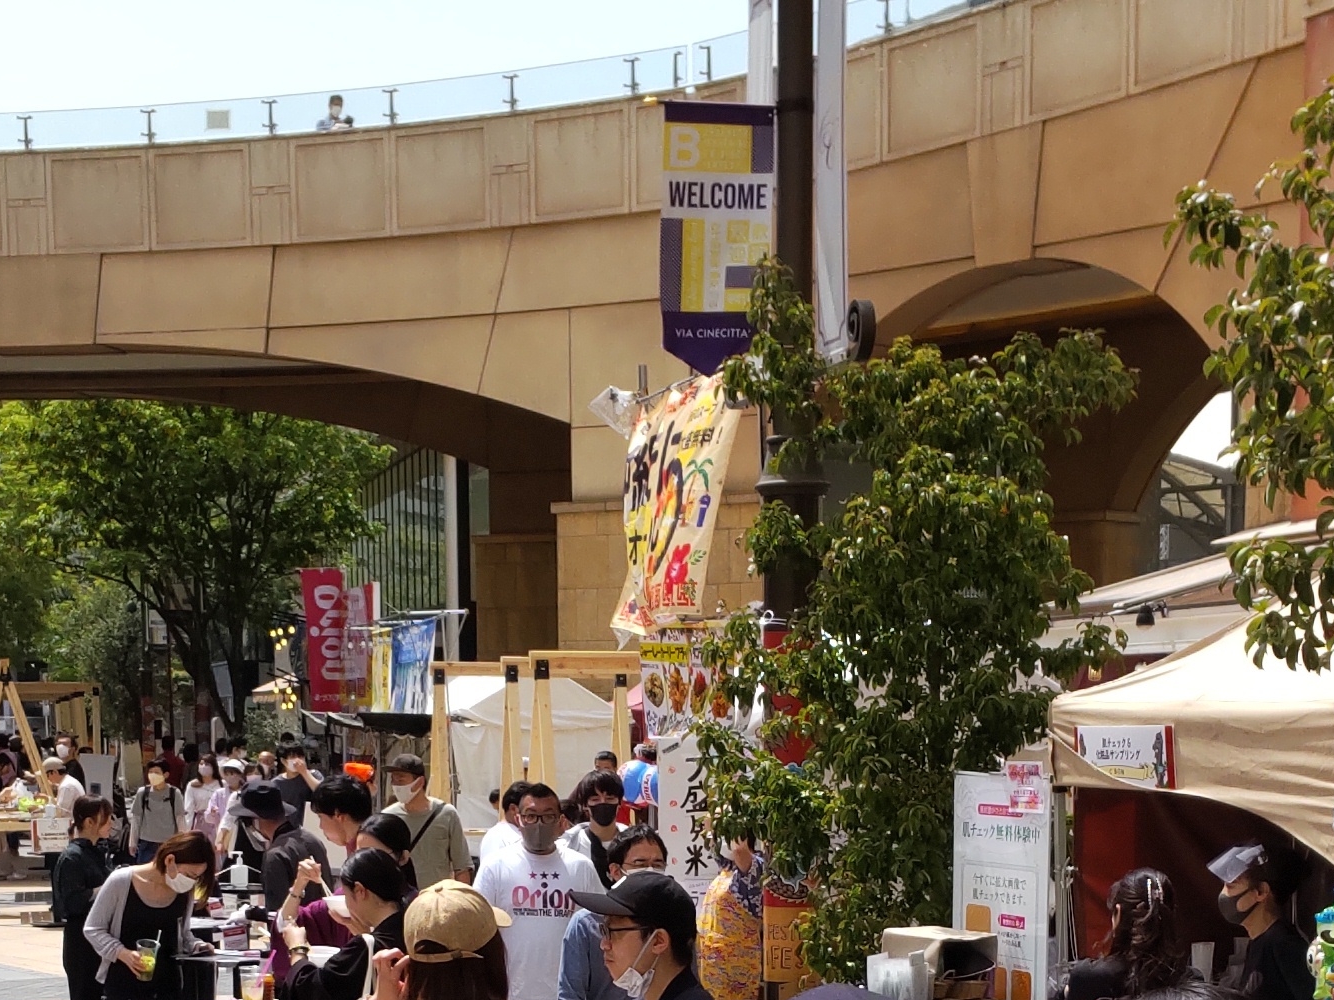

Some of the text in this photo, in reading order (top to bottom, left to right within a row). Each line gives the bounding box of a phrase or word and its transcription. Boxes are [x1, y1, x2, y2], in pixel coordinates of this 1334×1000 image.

[668, 180, 768, 210] WELCOME
[675, 328, 694, 339] VIA
[962, 821, 1041, 844] 肌チェック無料体験中
[511, 881, 576, 911] Orion
[539, 908, 553, 917] THE
